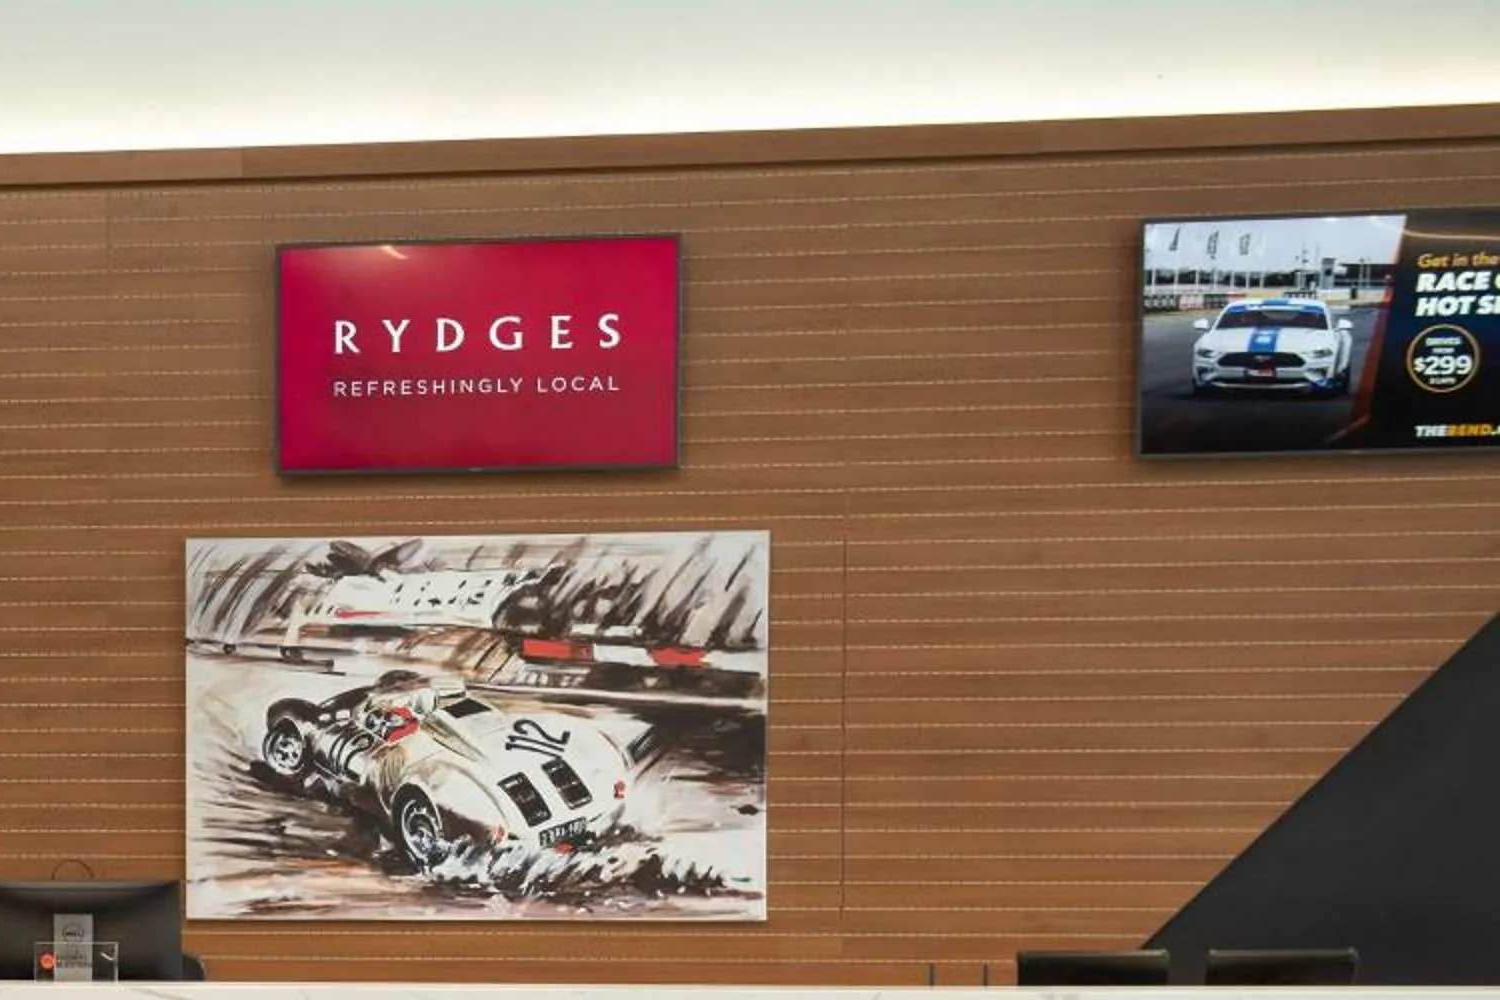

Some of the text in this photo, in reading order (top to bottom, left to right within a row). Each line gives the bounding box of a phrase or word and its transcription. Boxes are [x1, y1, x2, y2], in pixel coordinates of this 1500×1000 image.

[1416, 271, 1492, 292] RACE
[1415, 295, 1476, 316] HOT
[334, 313, 621, 354] RYDGES
[1414, 355, 1473, 375] $299
[333, 376, 621, 397] REFRESHINGLY LOCAL
[1414, 423, 1500, 438] THEBEND.
